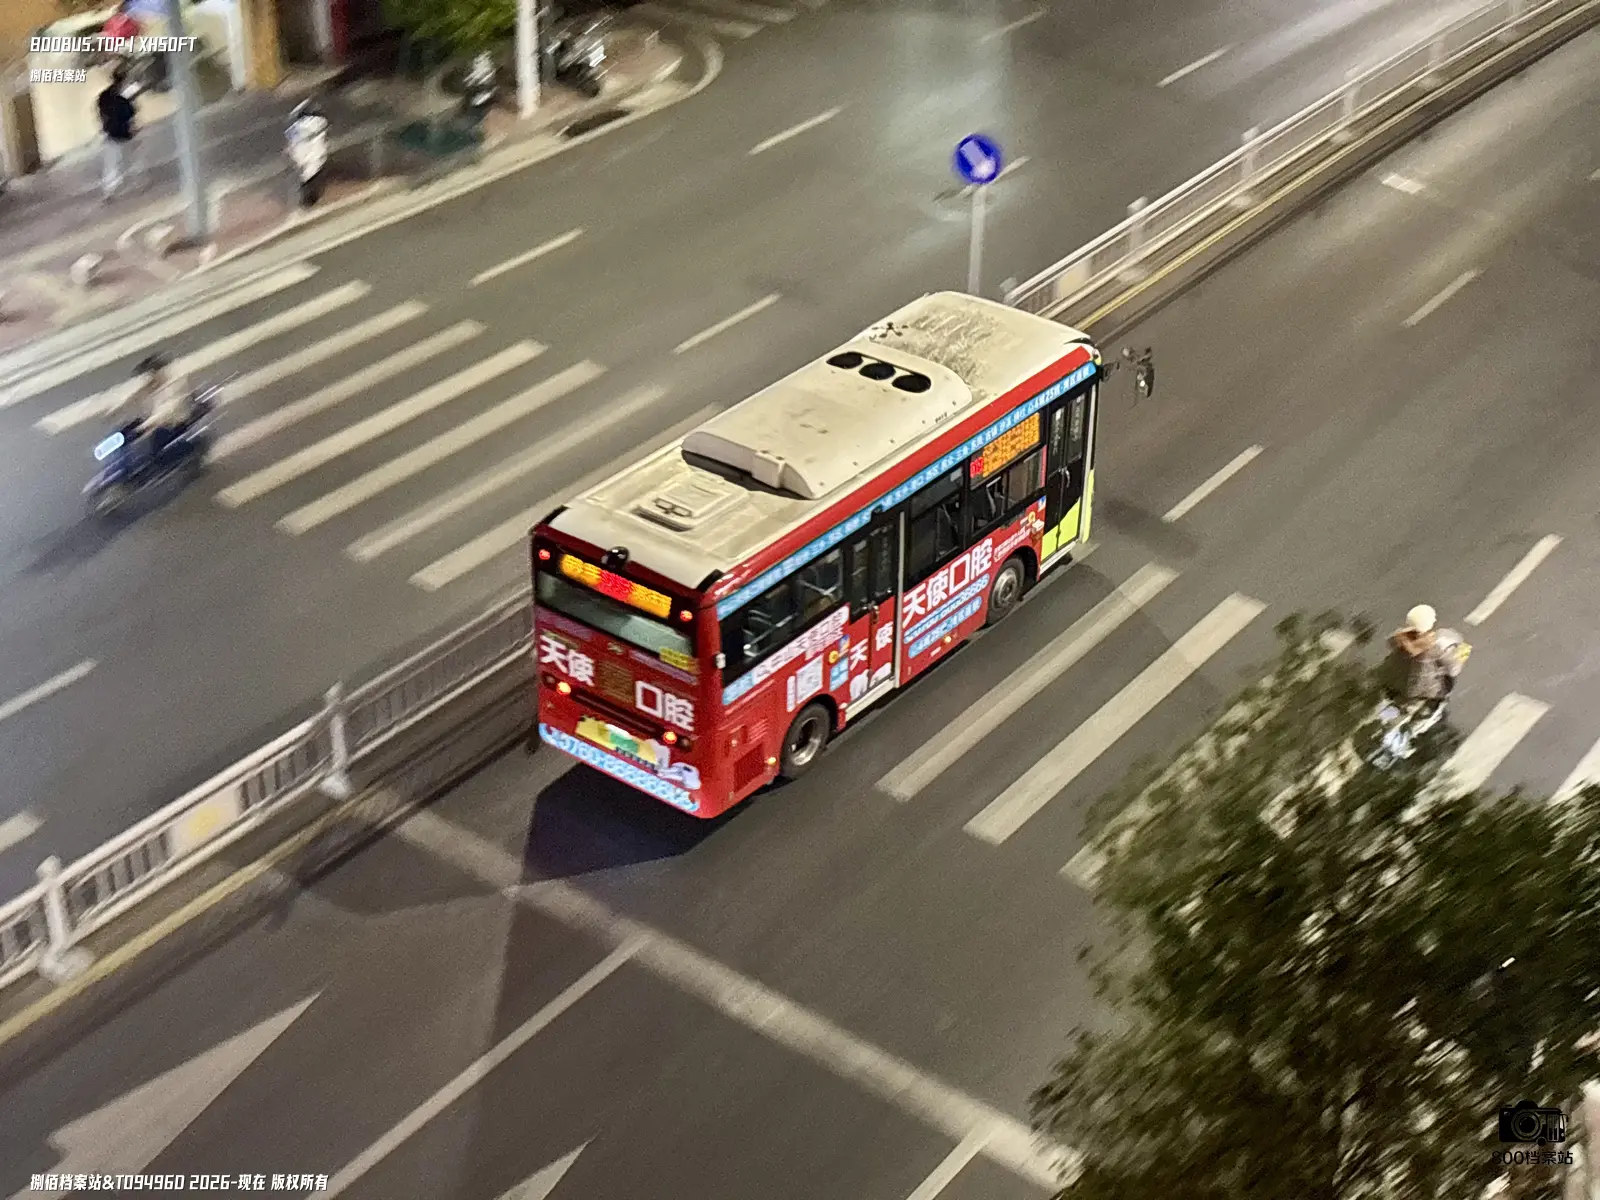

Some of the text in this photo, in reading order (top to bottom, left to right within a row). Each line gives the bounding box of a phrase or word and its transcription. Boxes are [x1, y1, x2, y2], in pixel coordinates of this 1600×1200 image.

[903, 538, 993, 628] 天使口腔
[539, 634, 595, 687] 天使
[635, 680, 695, 732] 口腔
